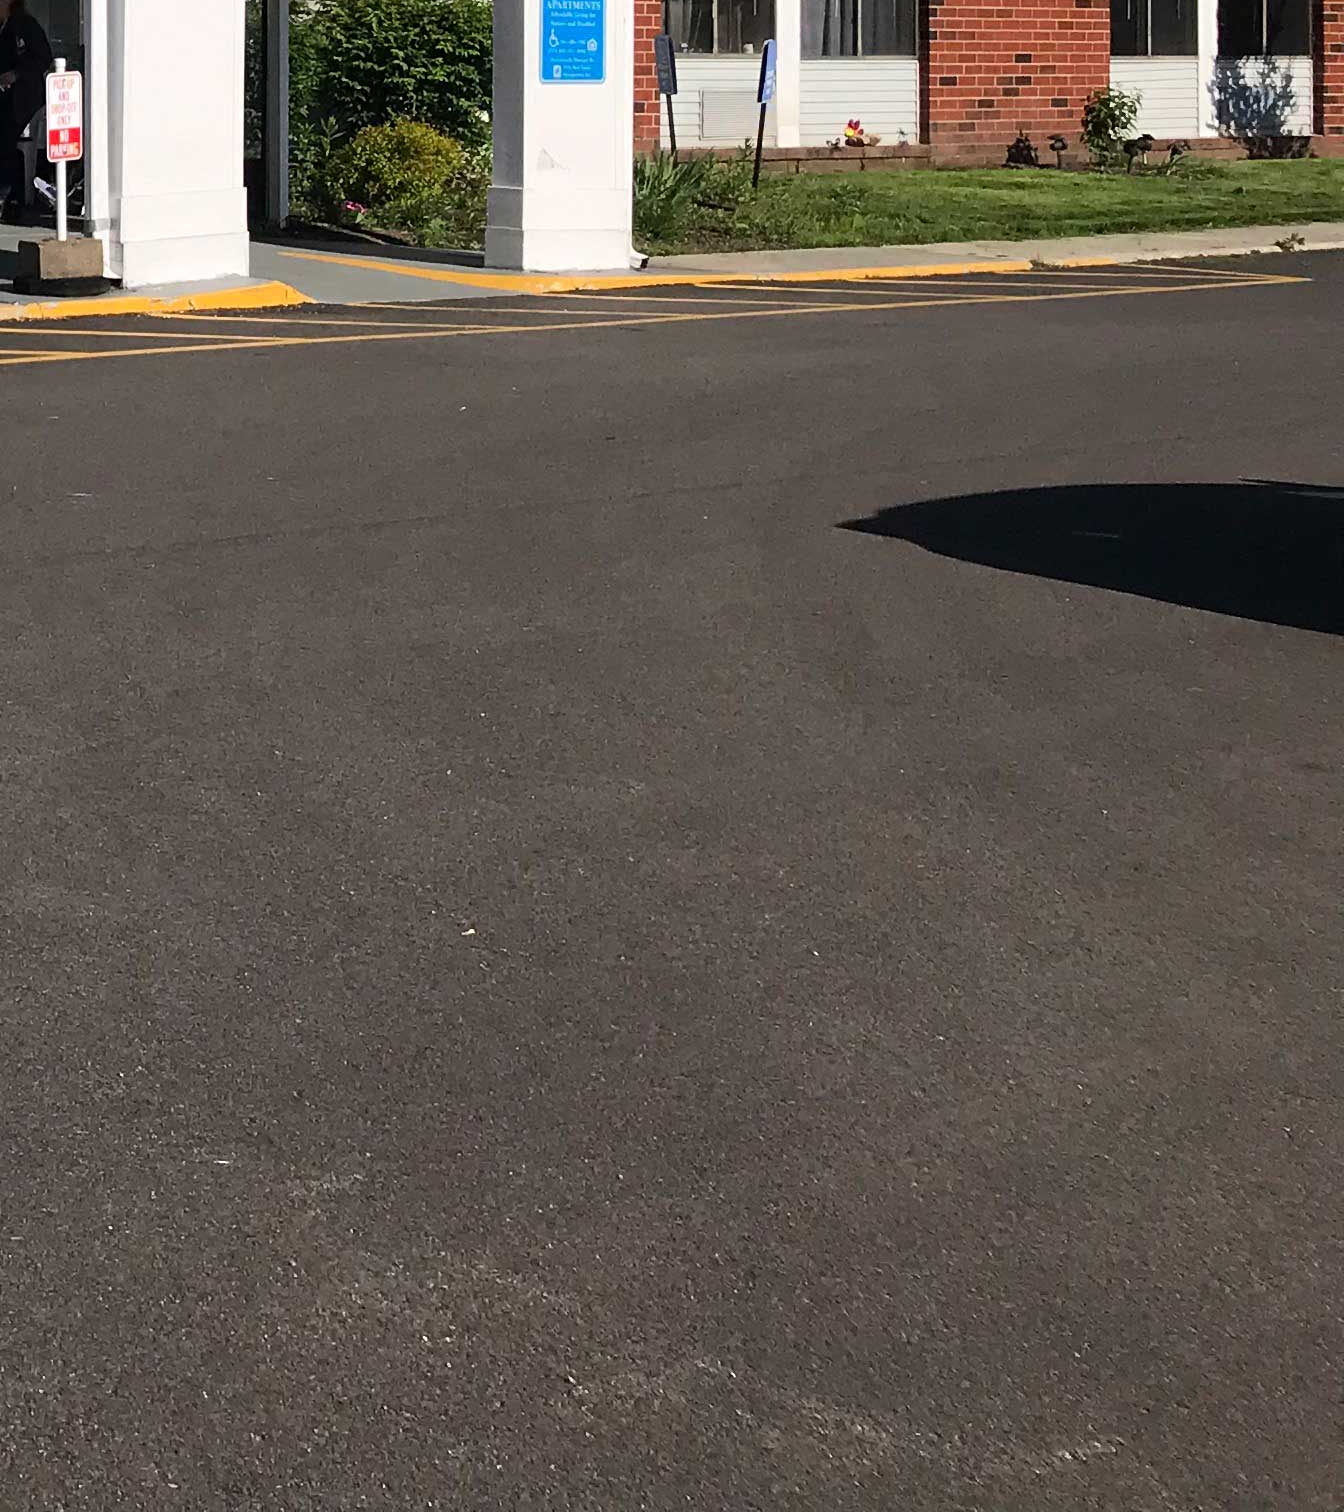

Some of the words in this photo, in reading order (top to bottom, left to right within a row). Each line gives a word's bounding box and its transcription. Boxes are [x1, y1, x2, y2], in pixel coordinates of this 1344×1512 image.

[547, 0, 600, 11] APARTMENTS
[58, 91, 70, 102] AND
[57, 115, 71, 126] ONLY
[59, 129, 70, 144] NO
[50, 142, 80, 158] PARKING
